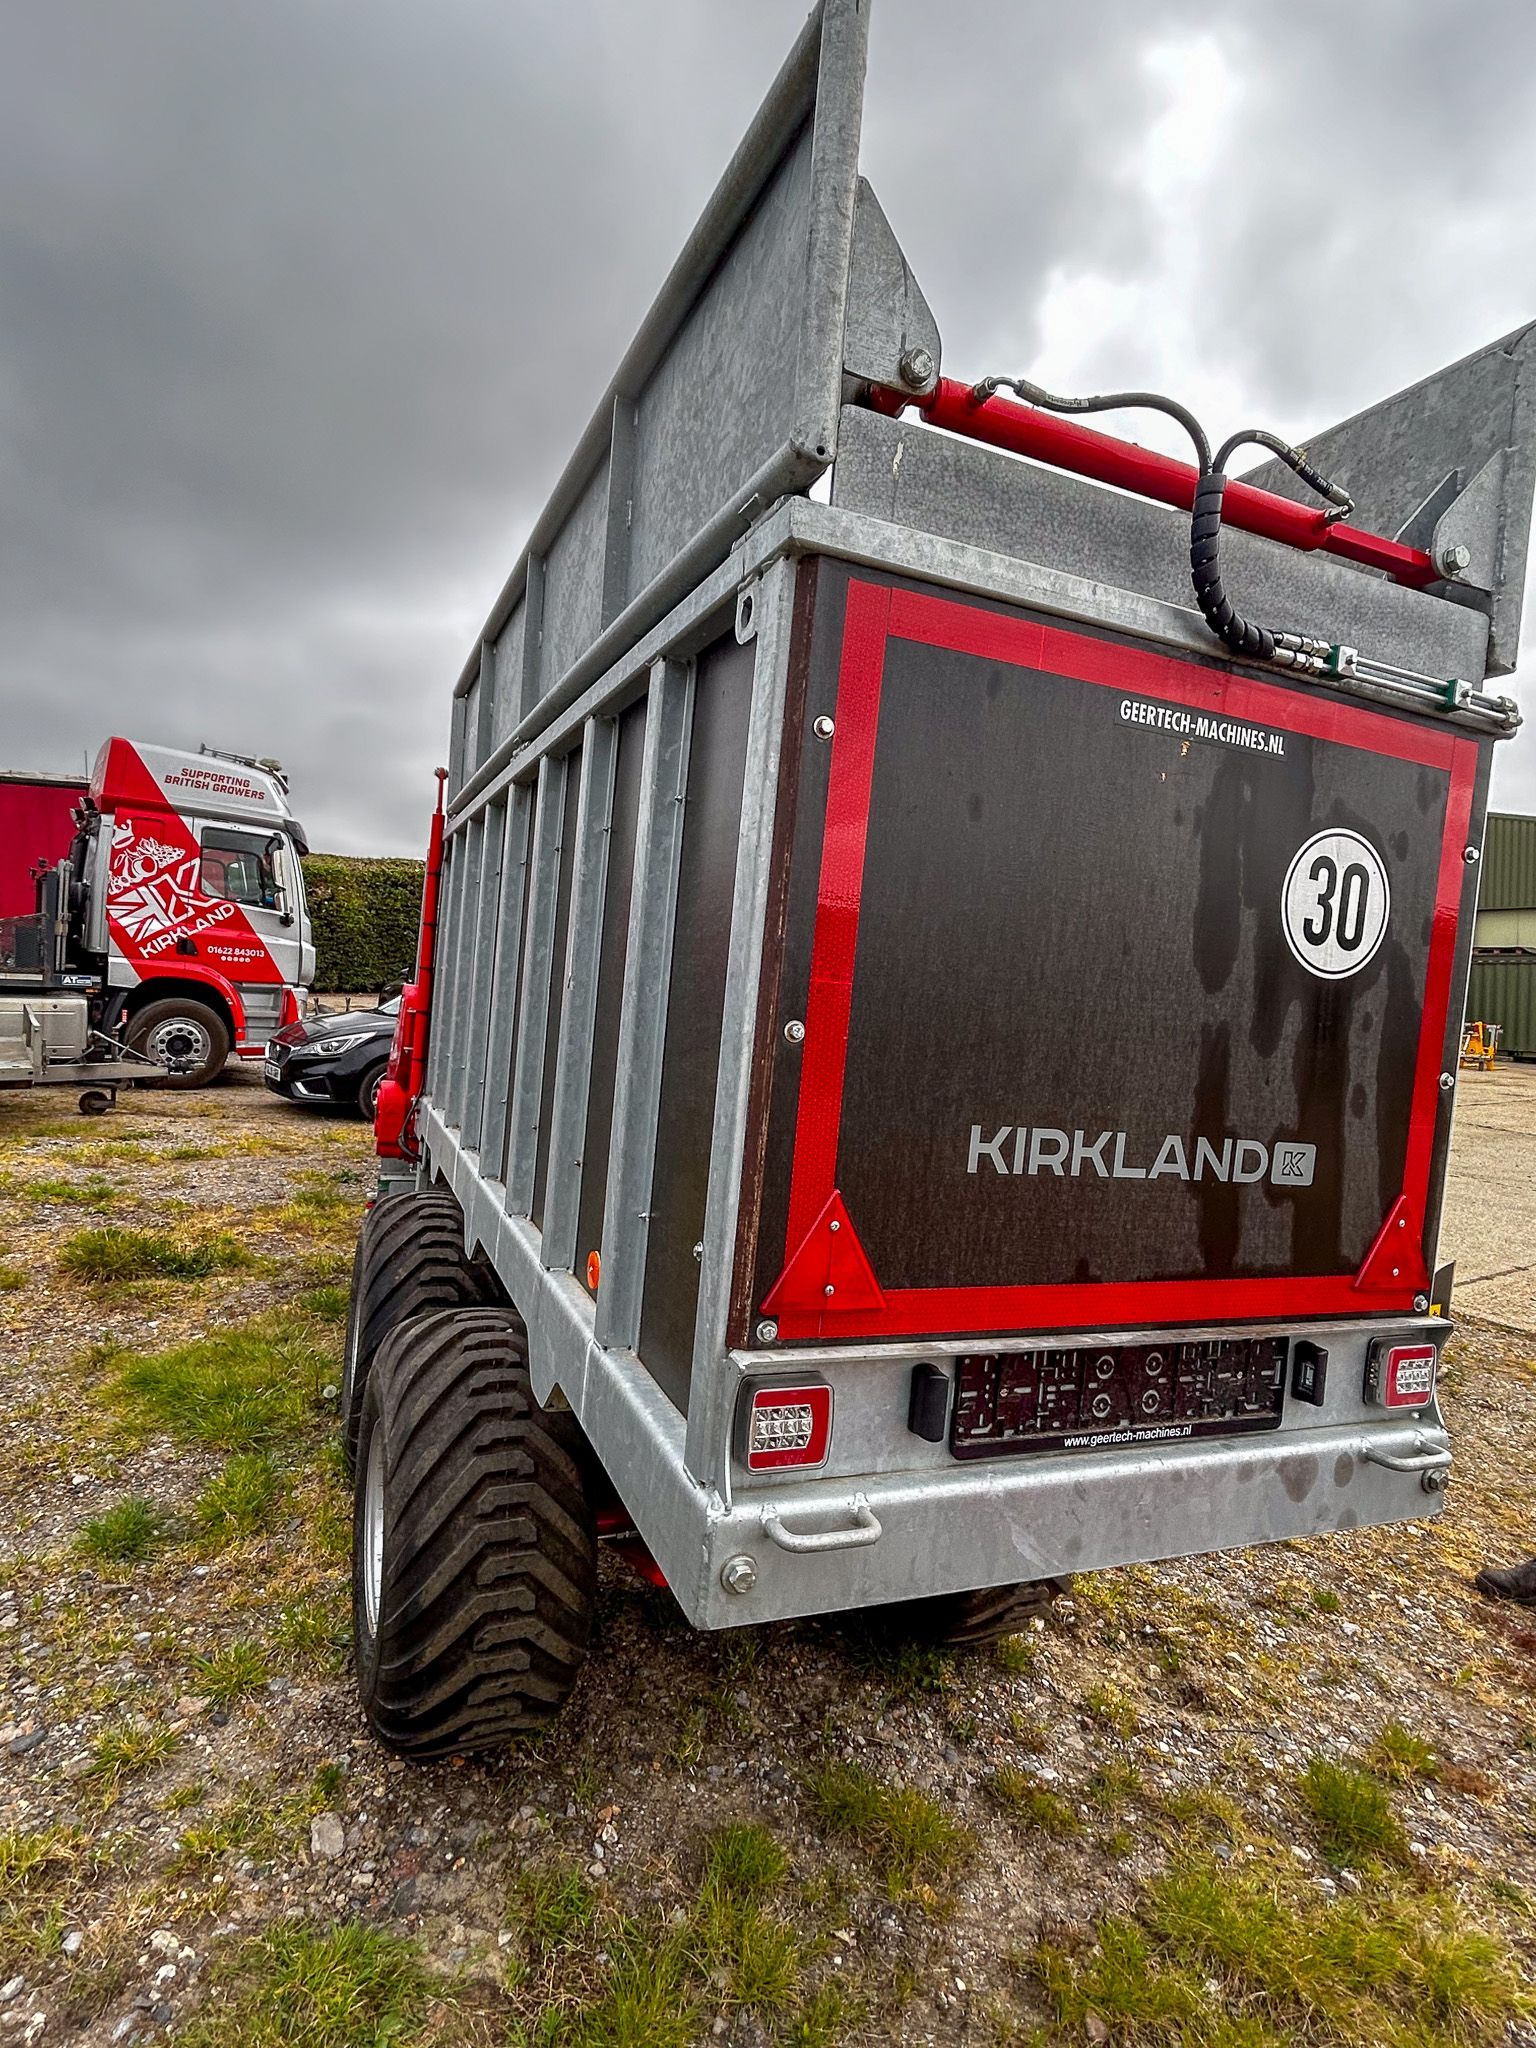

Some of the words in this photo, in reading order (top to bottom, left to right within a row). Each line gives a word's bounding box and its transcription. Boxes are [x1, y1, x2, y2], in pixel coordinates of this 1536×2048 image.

[1119, 699, 1285, 756] GEERTECH-MACHINES.NL
[164, 774, 210, 791] BRITISH
[212, 783, 265, 800] GROWERS
[180, 768, 251, 788] SUPPORTING
[1302, 855, 1370, 952] 30
[138, 903, 235, 959] KIRKLAND
[207, 945, 232, 955] 01622
[234, 947, 265, 957] 843013
[966, 1124, 1269, 1184] KIRKLAND
[1064, 1425, 1192, 1447] www.geertech-machines.nl
